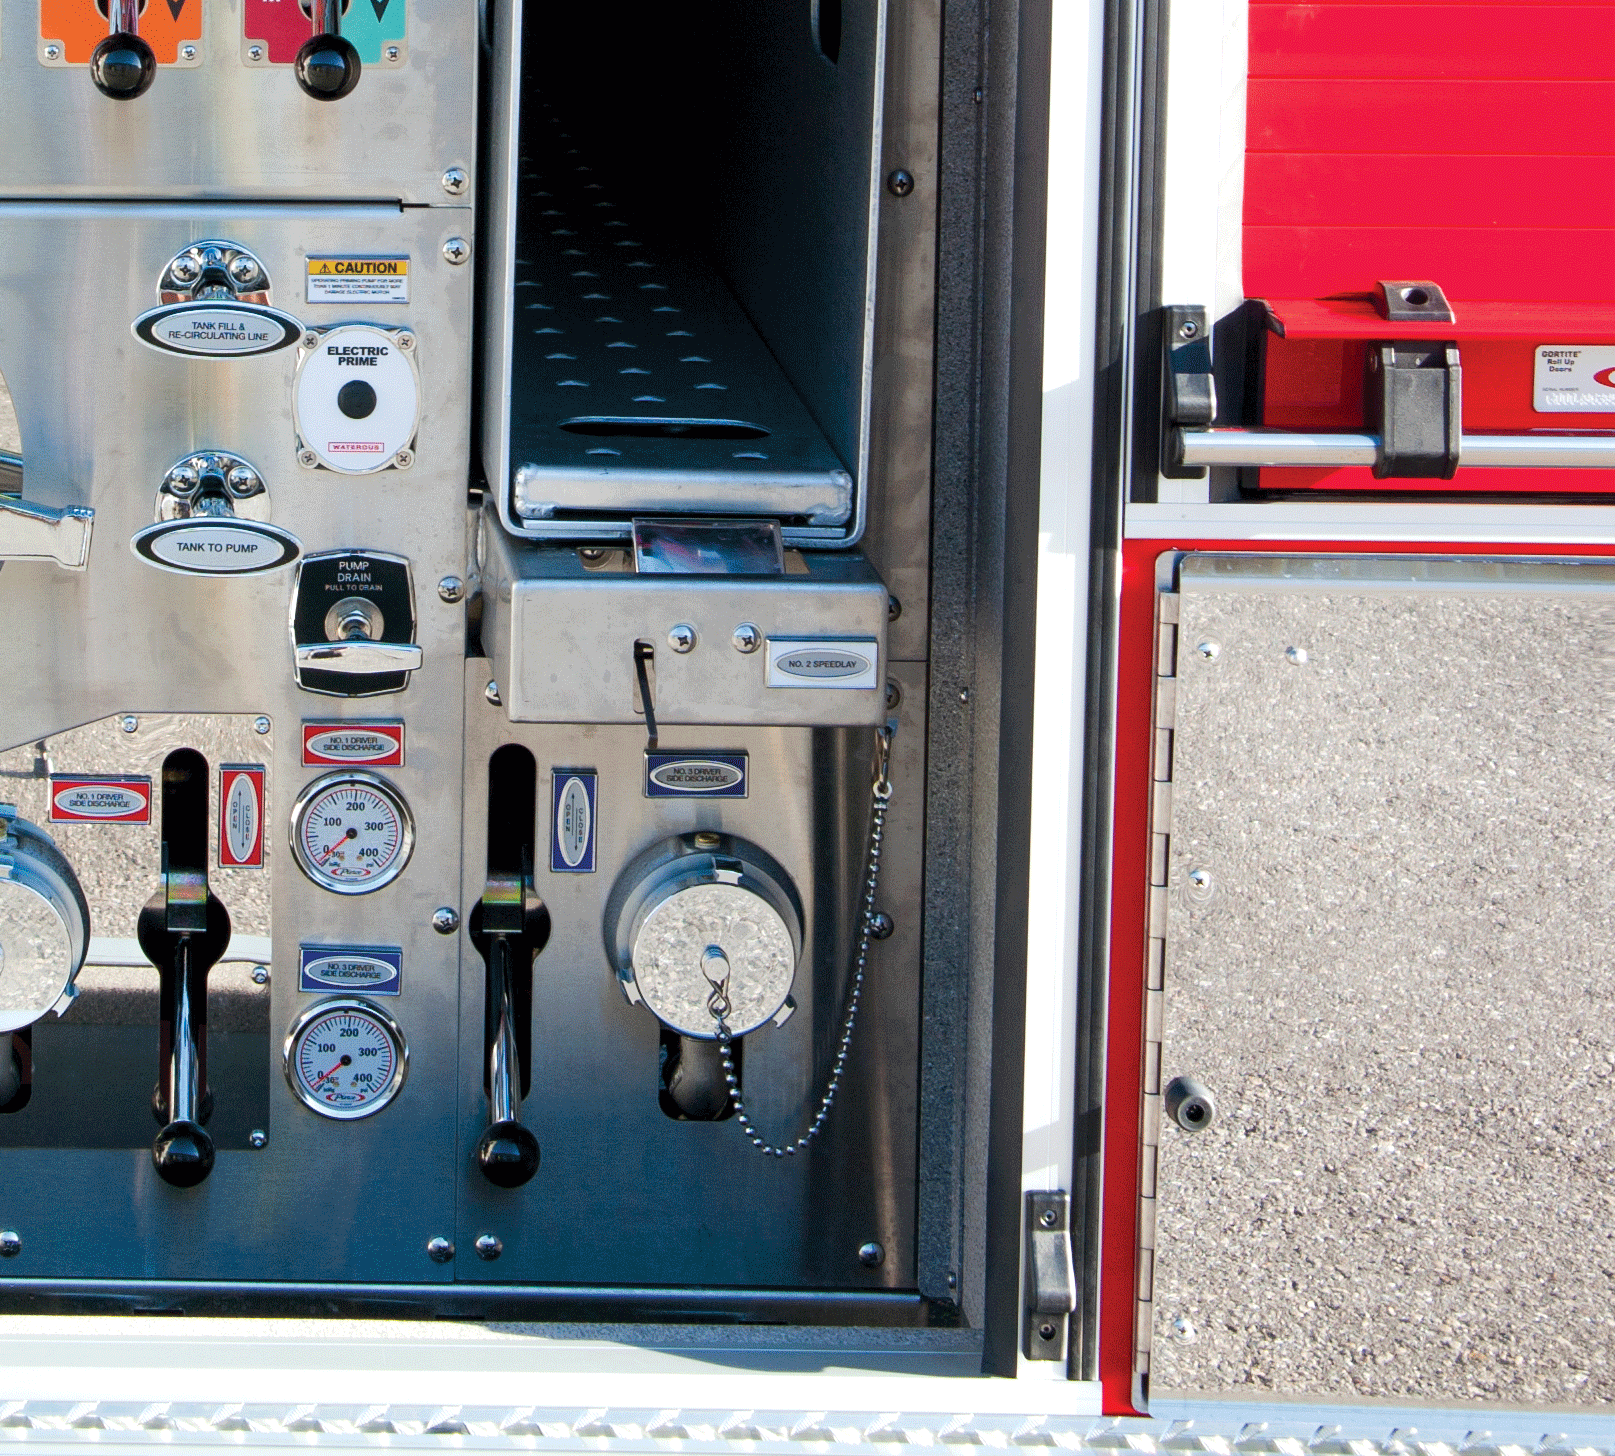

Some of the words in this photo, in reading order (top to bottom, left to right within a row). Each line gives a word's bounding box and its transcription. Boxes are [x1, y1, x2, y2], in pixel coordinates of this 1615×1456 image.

[335, 262, 397, 274] CAUTION
[192, 322, 215, 330] TANK
[219, 323, 236, 331] FILL
[239, 323, 245, 331] &
[169, 331, 245, 340] RE-CIRCULATING
[248, 332, 268, 340] LINE
[327, 347, 388, 356] ELECTRIC
[338, 357, 377, 366] PRIME
[177, 543, 204, 551] TANK
[208, 543, 222, 552] TO
[226, 544, 258, 553] PUMP
[339, 562, 369, 570] PUMP
[338, 573, 371, 581] DRAIN
[346, 802, 365, 811] 200
[324, 818, 342, 826] 100
[364, 822, 383, 831] 300
[359, 848, 378, 857] 400
[339, 971, 381, 979] DISCHARGE
